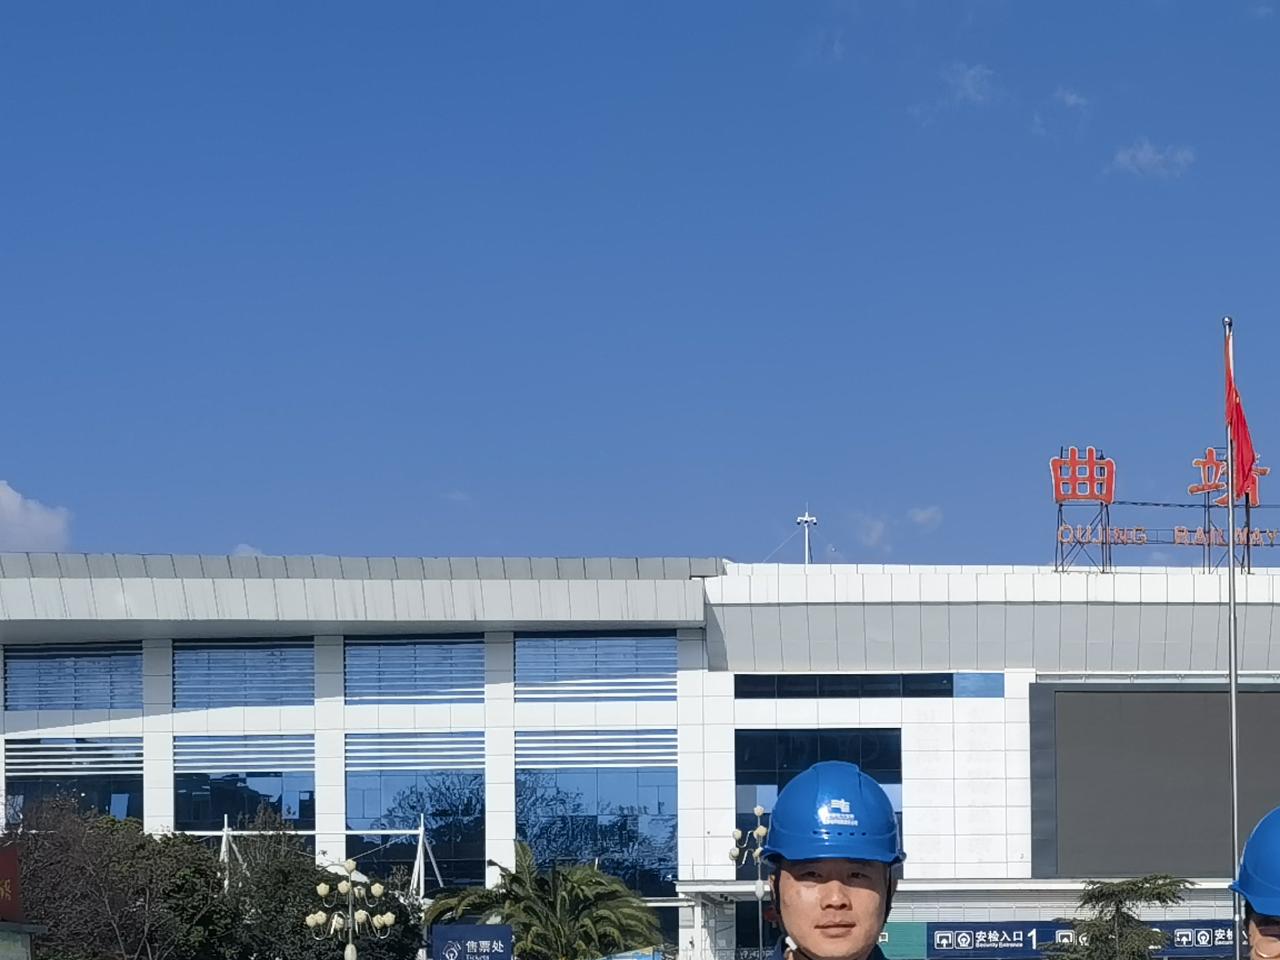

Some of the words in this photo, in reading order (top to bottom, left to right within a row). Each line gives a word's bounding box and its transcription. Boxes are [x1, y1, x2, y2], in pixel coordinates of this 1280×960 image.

[466, 940, 504, 953] 售票处
[975, 931, 1023, 942] 安检入口
[1027, 928, 1037, 950] 1
